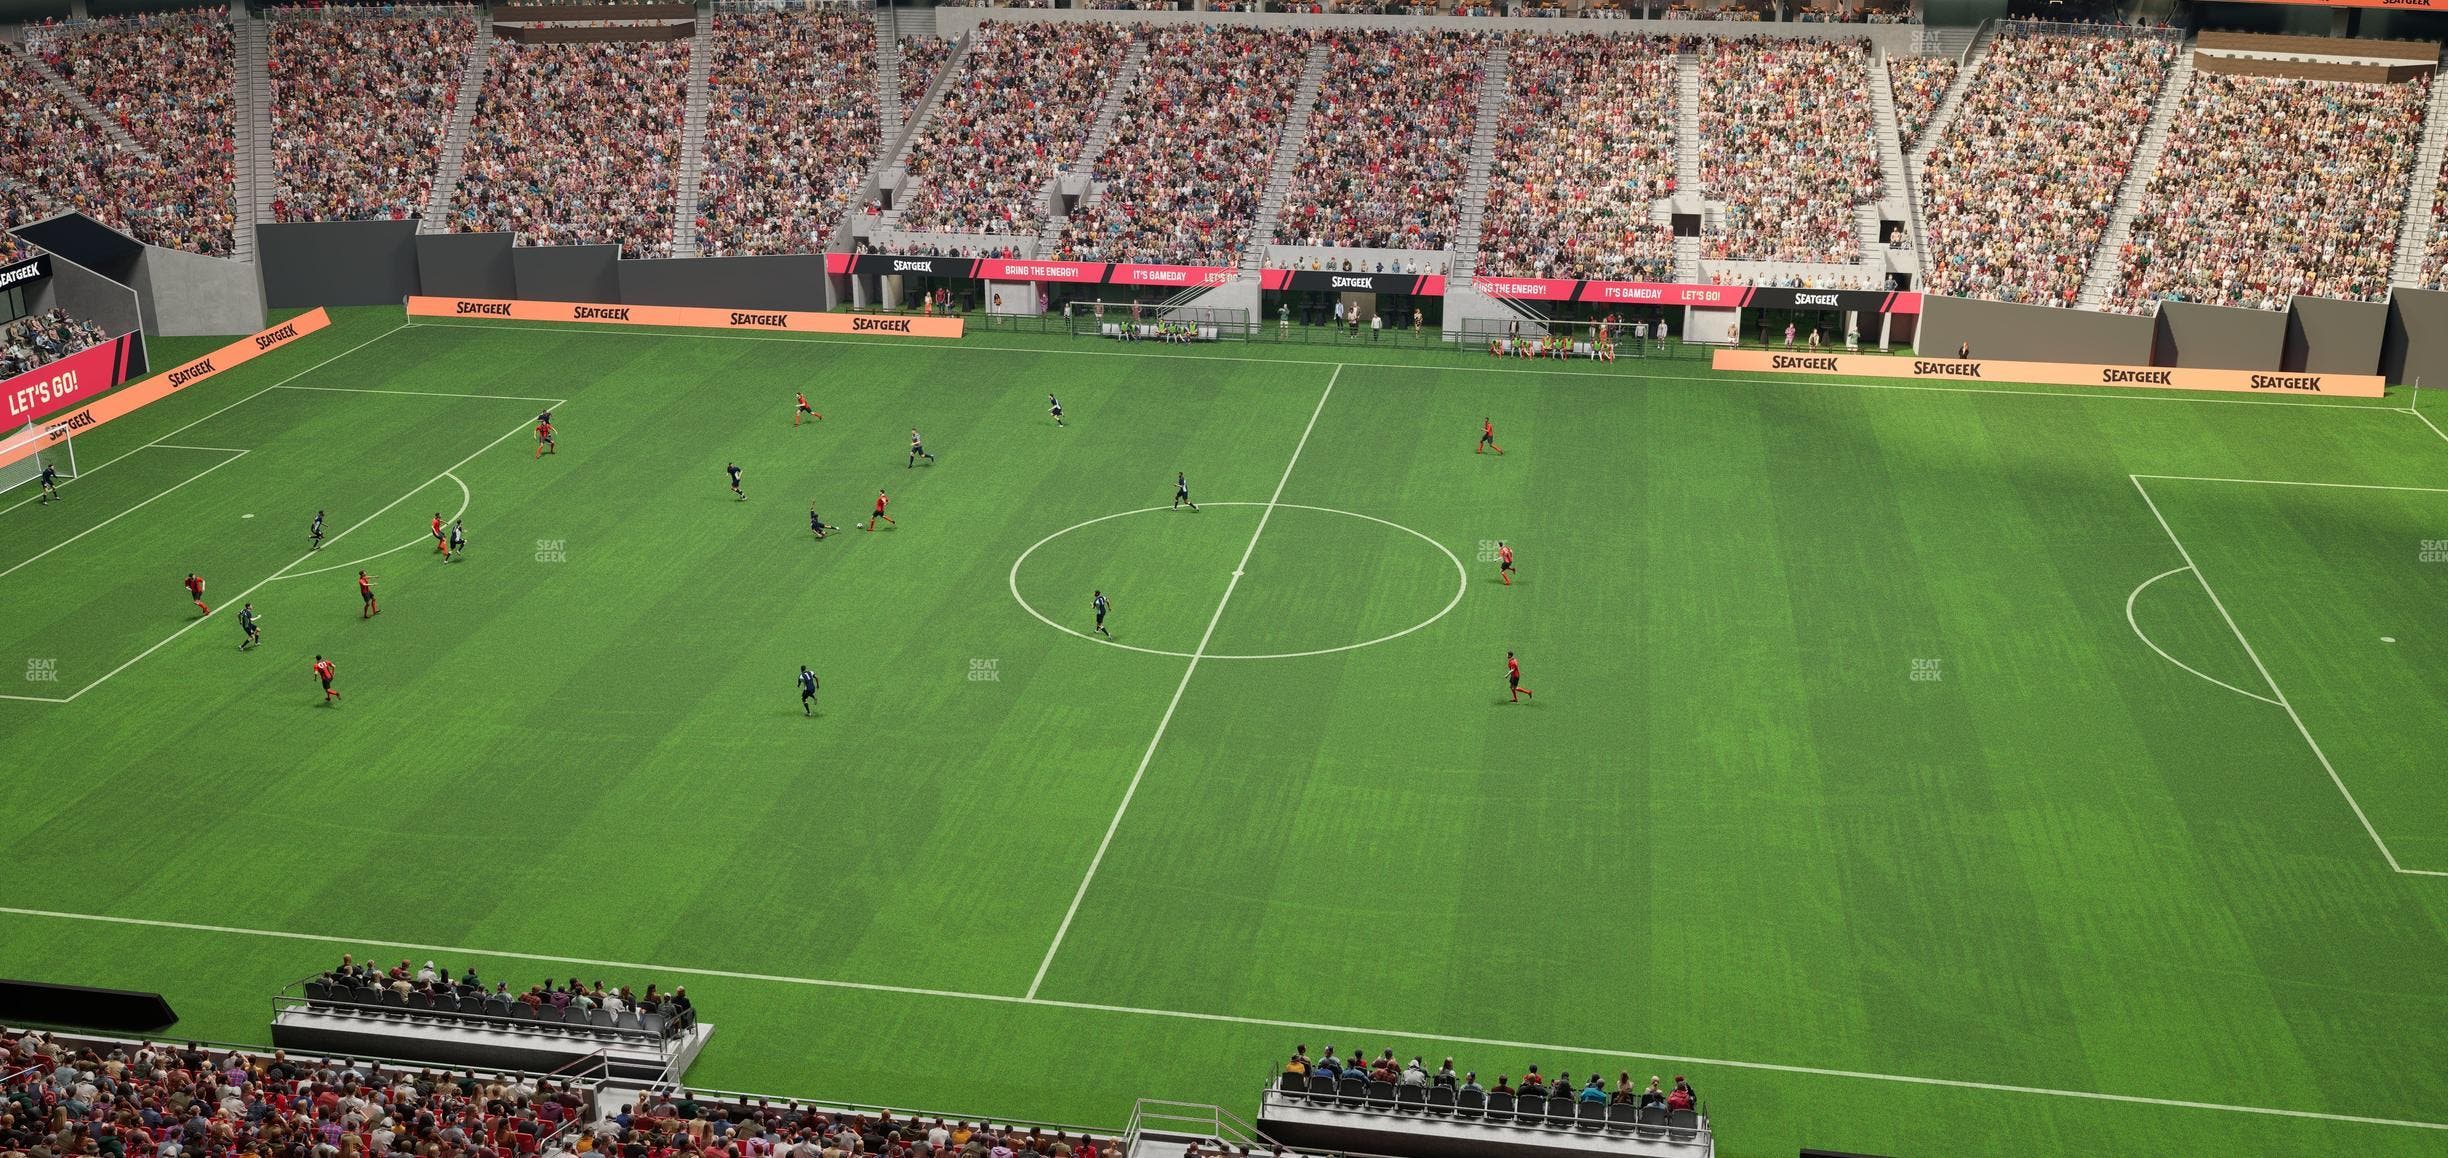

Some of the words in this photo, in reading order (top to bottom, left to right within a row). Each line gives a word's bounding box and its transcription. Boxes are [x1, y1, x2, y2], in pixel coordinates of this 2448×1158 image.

[893, 260, 932, 273] SEATGEEK
[1005, 266, 1028, 275] BRING
[1030, 266, 1045, 276] THE
[1046, 267, 1079, 278] ENERGY!
[1133, 270, 1148, 280] IT'S
[1149, 271, 1187, 281] GAMEDAY
[1332, 276, 1373, 289] SEATGEEK
[1495, 284, 1511, 293] THE
[1512, 284, 1546, 295] ENERGY!
[1605, 287, 1621, 298] IT'S
[1622, 288, 1662, 299] GAMEDAY
[1681, 290, 1704, 301] LET'S
[1705, 291, 1720, 301] GO!
[1795, 293, 1839, 306] SEATGEEK
[456, 301, 512, 316] SEATGEEK
[574, 306, 629, 321] SEATGEEK
[730, 313, 787, 328] SEATGEEK
[852, 317, 911, 333] SEATGEEK
[255, 323, 298, 350] SEATGEEK
[1772, 355, 1838, 371] SEATGEEK
[1914, 361, 1981, 377] SEATGEEK
[168, 358, 216, 388] SEATGEEK
[2103, 368, 2172, 385] SEATGEEK
[2251, 375, 2321, 391] SEATGEEK
[8, 381, 51, 416] LET'S
[52, 370, 79, 398] GO!
